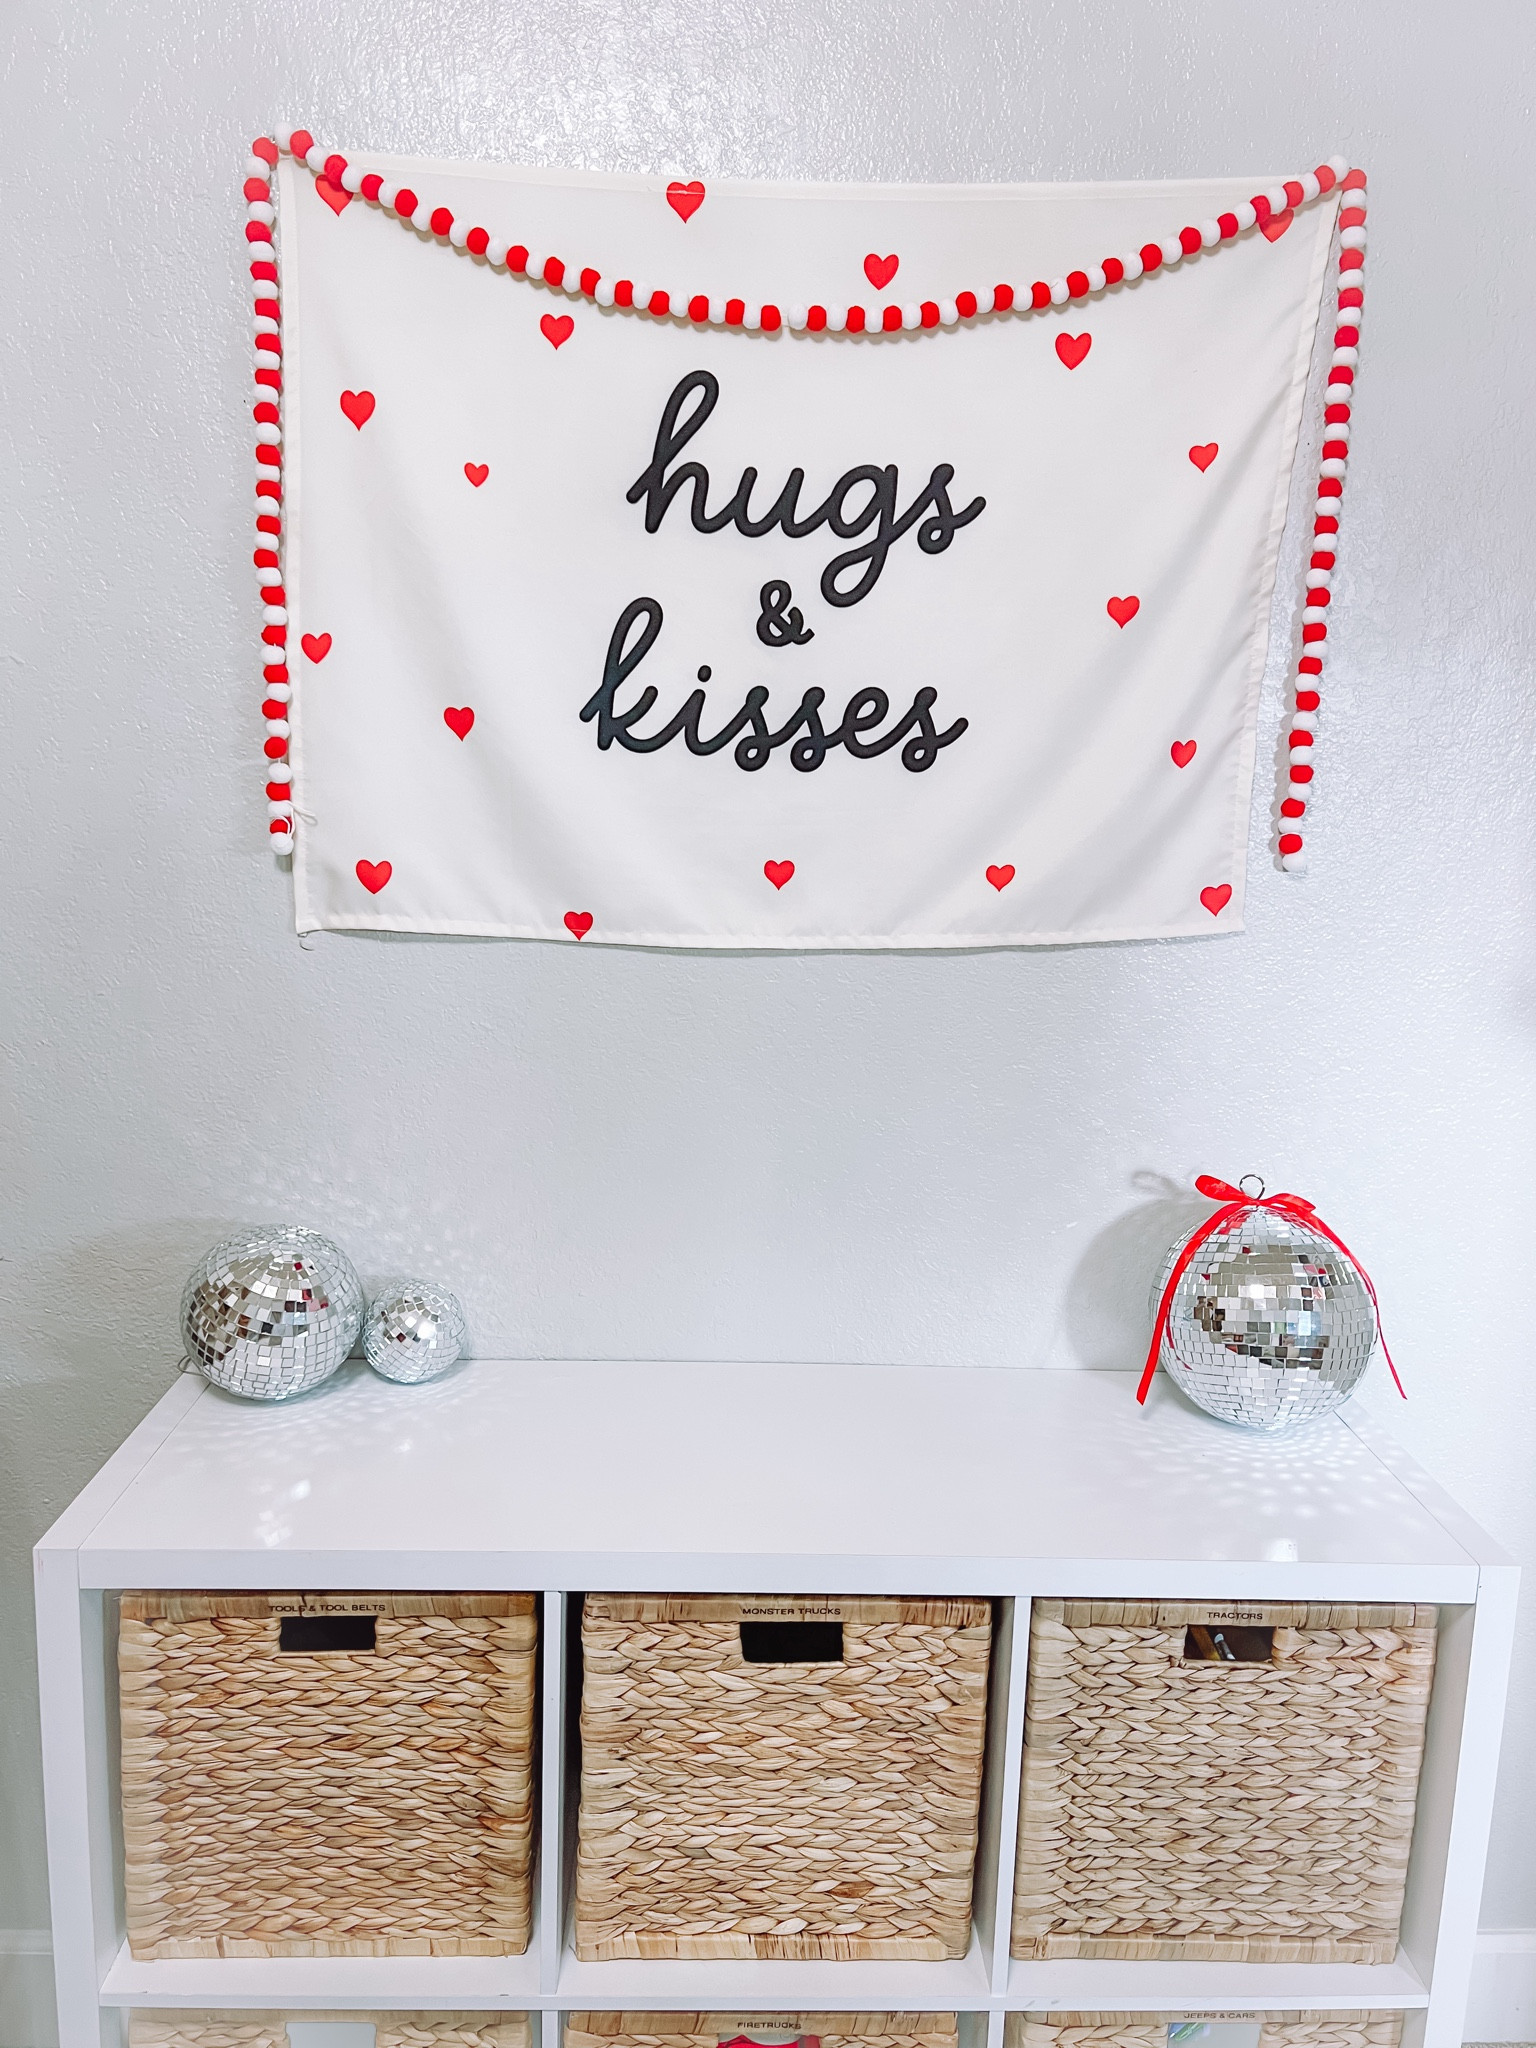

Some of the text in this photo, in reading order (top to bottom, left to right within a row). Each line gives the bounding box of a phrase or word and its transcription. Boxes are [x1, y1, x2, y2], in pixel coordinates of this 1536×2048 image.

[626, 370, 987, 608] hugs
[756, 579, 815, 647] &
[579, 597, 969, 773] kisses
[320, 1604, 348, 1612] TOOL
[351, 1604, 386, 1612] BELTS
[1207, 1611, 1263, 1620] TRACTORS
[737, 2022, 802, 2030] FIRETRUCKS
